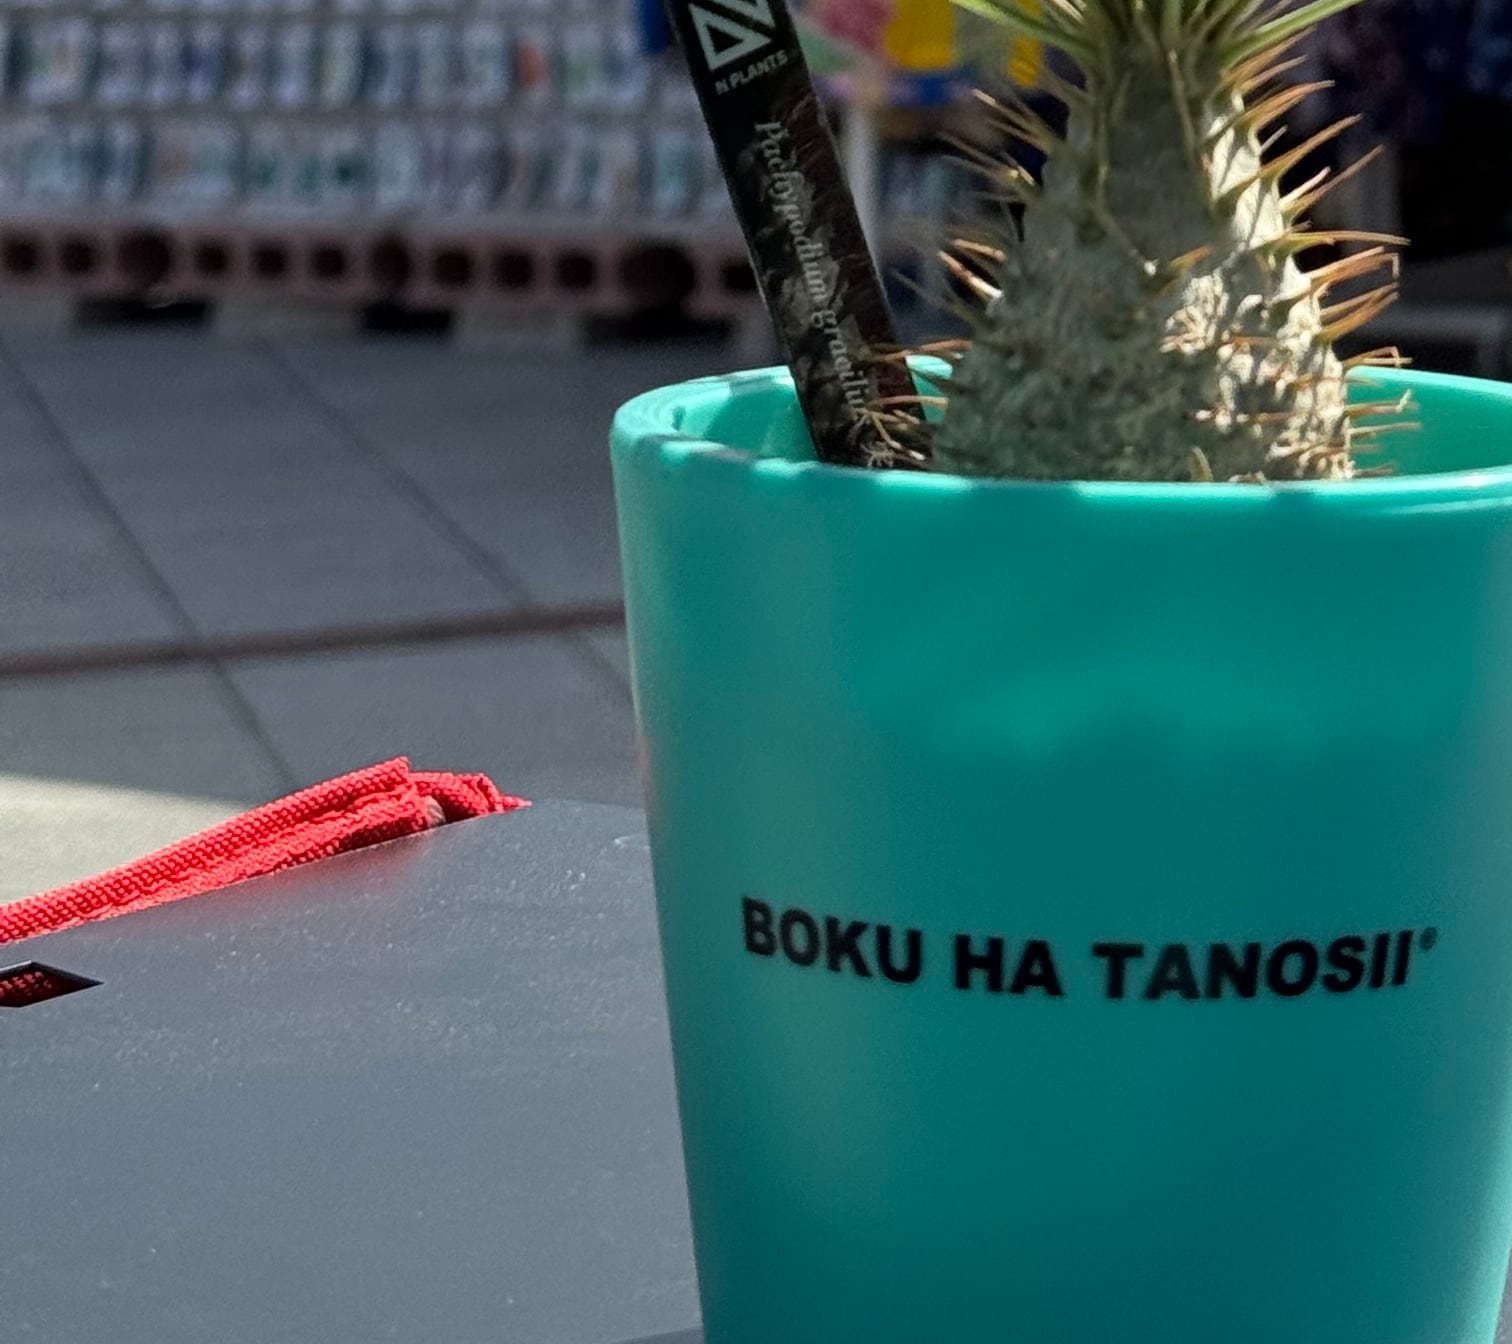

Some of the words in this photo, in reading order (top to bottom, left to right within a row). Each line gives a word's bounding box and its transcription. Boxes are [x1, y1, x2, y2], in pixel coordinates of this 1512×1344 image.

[714, 77, 729, 96] N
[729, 49, 789, 89] PLANTS
[754, 122, 828, 303] Pachypodium
[743, 895, 922, 984] BOKU
[954, 932, 1064, 997] HA
